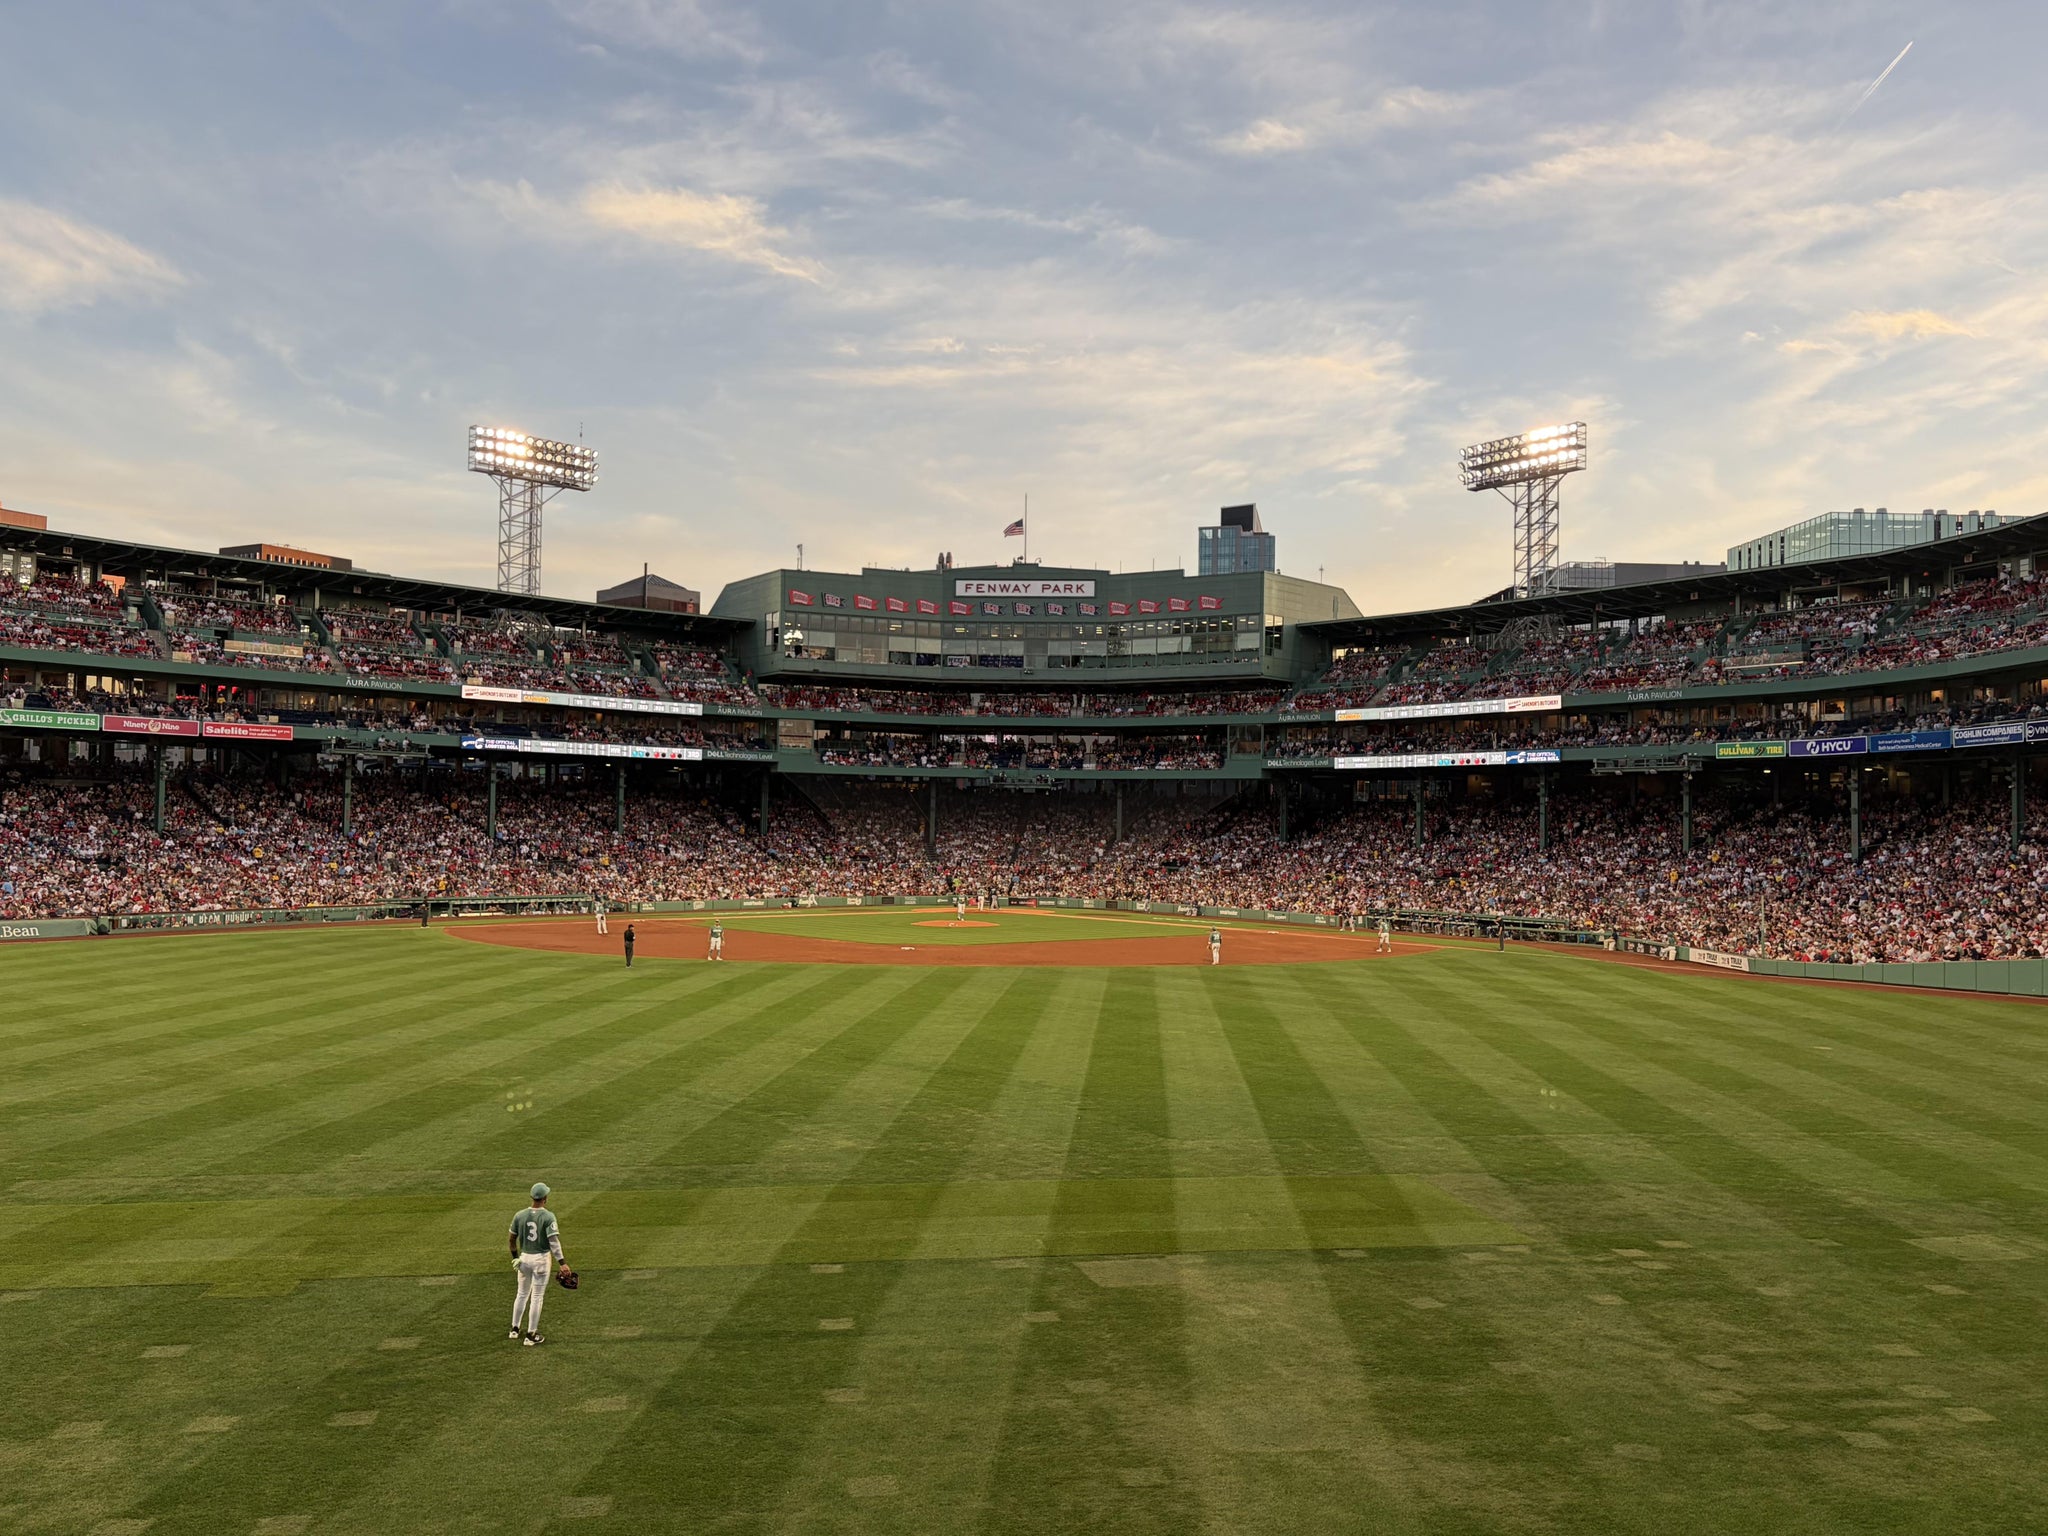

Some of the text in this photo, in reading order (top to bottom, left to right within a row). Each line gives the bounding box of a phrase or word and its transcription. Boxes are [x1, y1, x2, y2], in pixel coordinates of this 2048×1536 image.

[965, 584, 1085, 593] FENWAY PARK
[370, 680, 402, 690] PAVILION
[1651, 691, 1682, 699] PAVILION
[13, 713, 96, 726] GRILLO'S PICKLES
[124, 720, 148, 730] Ninety
[206, 726, 248, 736] Safelite
[1955, 729, 1982, 739] COGHLIN
[1983, 726, 2022, 737] COMPANIES
[1719, 745, 1783, 755] SULLIVAN TIRE
[1822, 741, 1850, 752] HYCU
[724, 751, 758, 760] Technologies
[527, 1222, 538, 1241] 3
